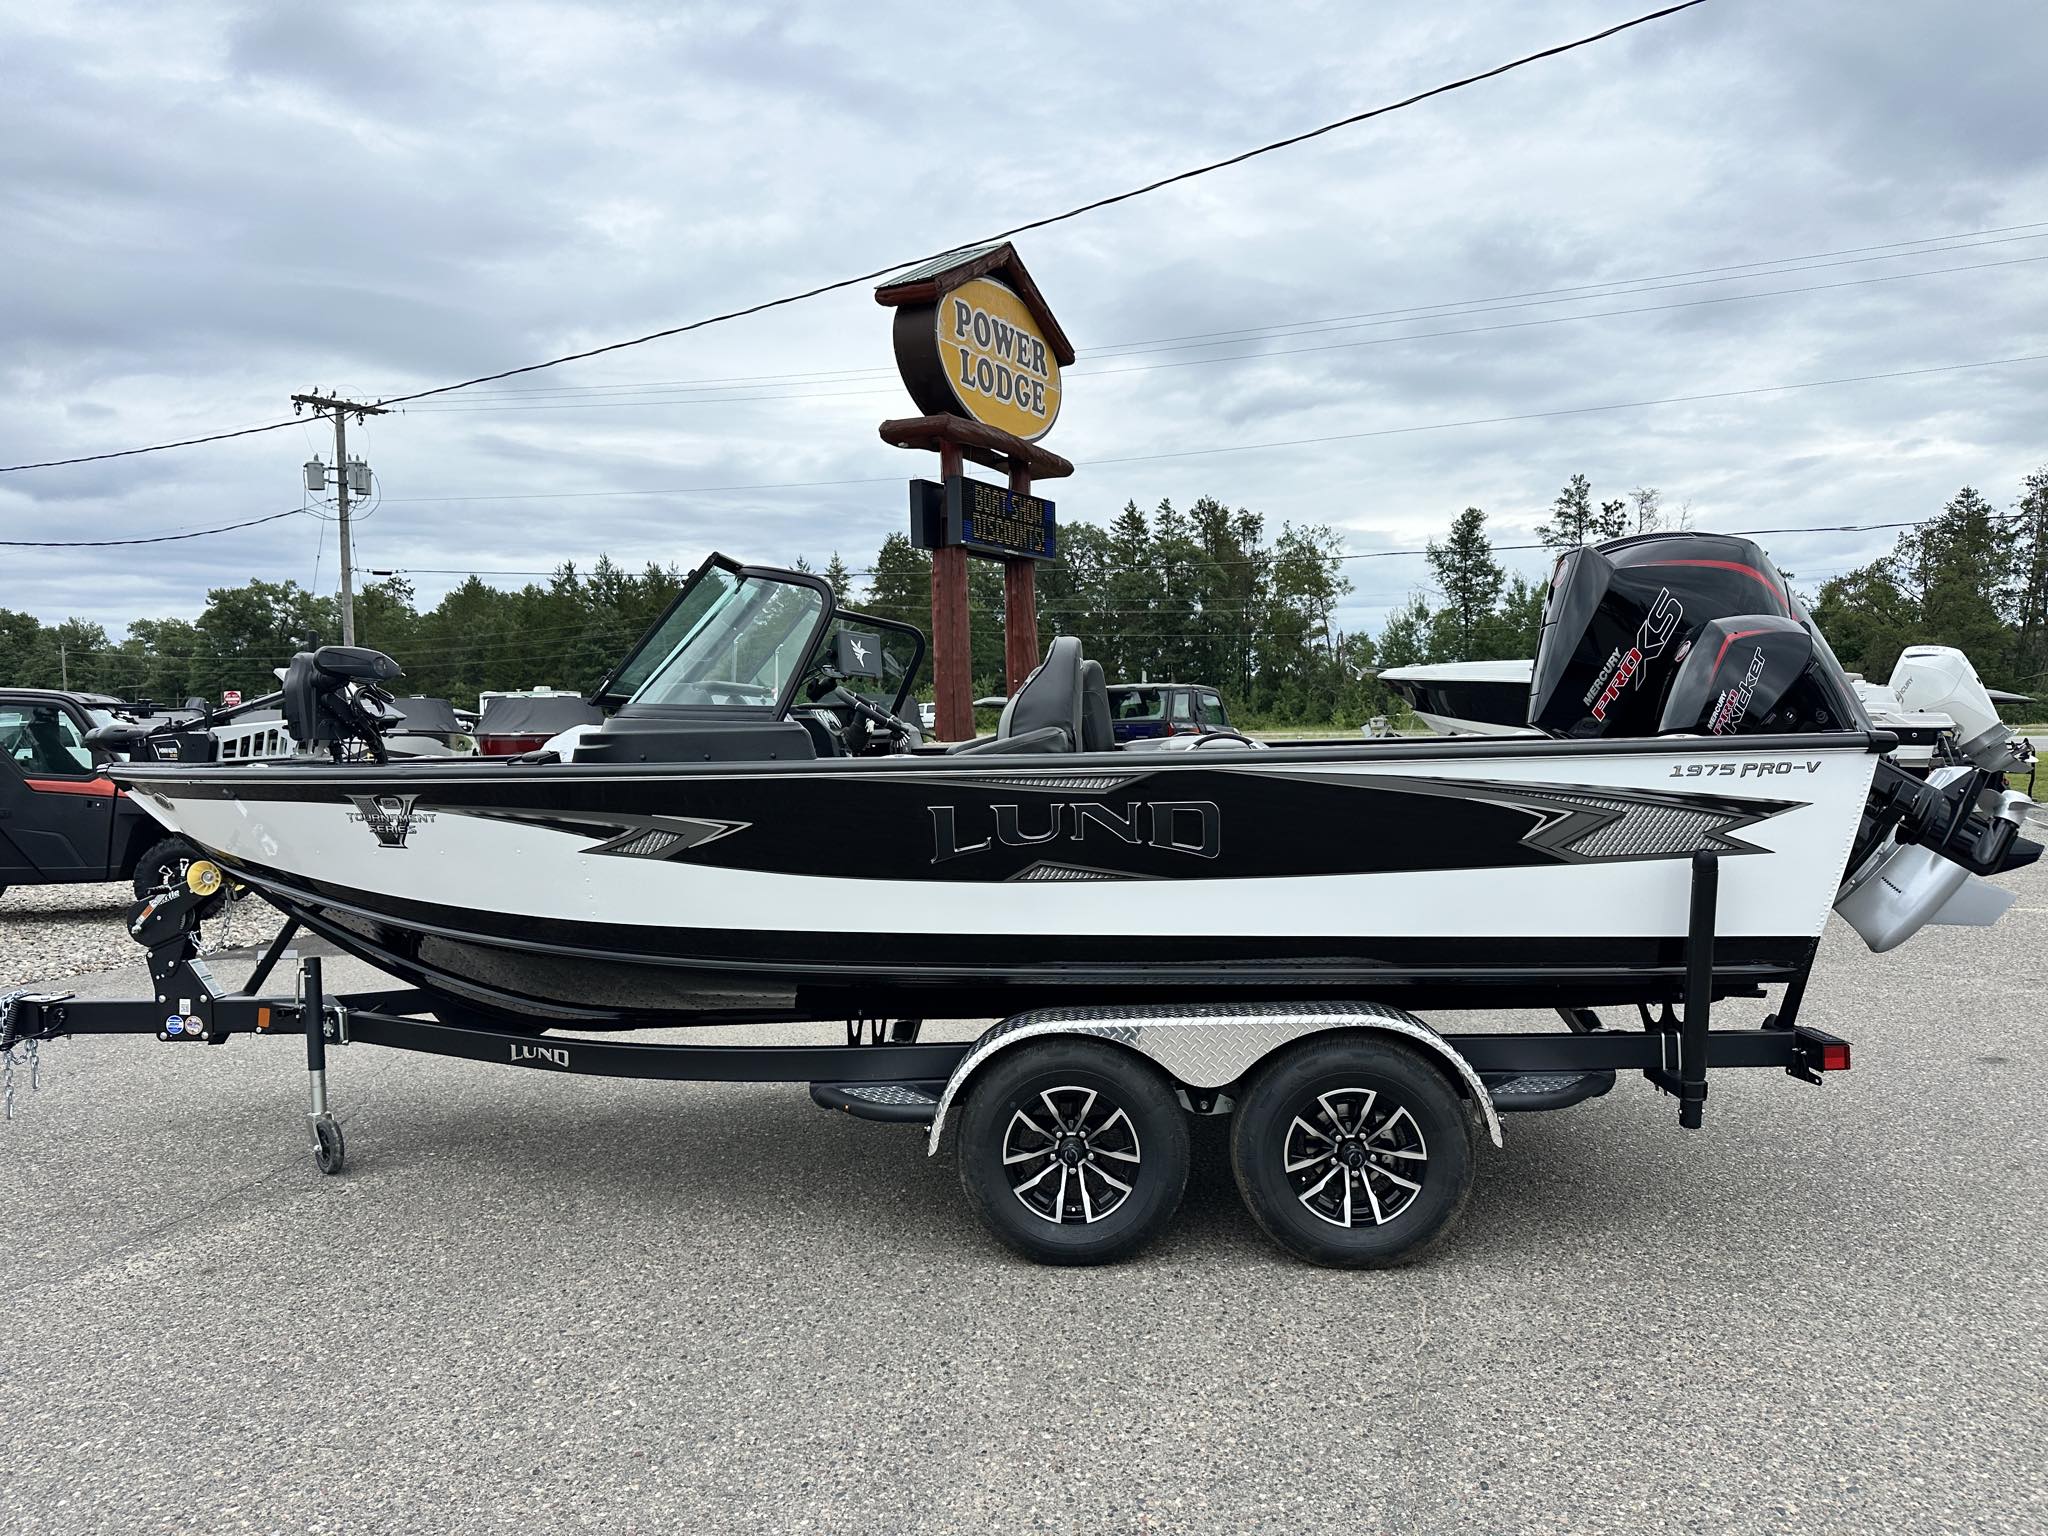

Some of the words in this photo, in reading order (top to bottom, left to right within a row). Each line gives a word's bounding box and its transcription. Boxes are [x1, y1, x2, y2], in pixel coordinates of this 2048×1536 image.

[954, 299, 1048, 377] POWER
[960, 347, 1046, 416] LODGE
[975, 484, 1008, 517] BOAT
[1583, 646, 1621, 706] MERCURY
[1592, 647, 1643, 722] PRO
[1634, 586, 1684, 692] XS
[1707, 689, 1727, 730] MERCURY
[1713, 688, 1739, 736] PRO
[1669, 763, 1737, 778] 1975
[1740, 761, 1822, 778] PRO-V
[345, 812, 437, 824] TOURNAMENT
[369, 824, 418, 835] SERIES
[927, 800, 1221, 865] LUND
[510, 1043, 570, 1068] LUND
